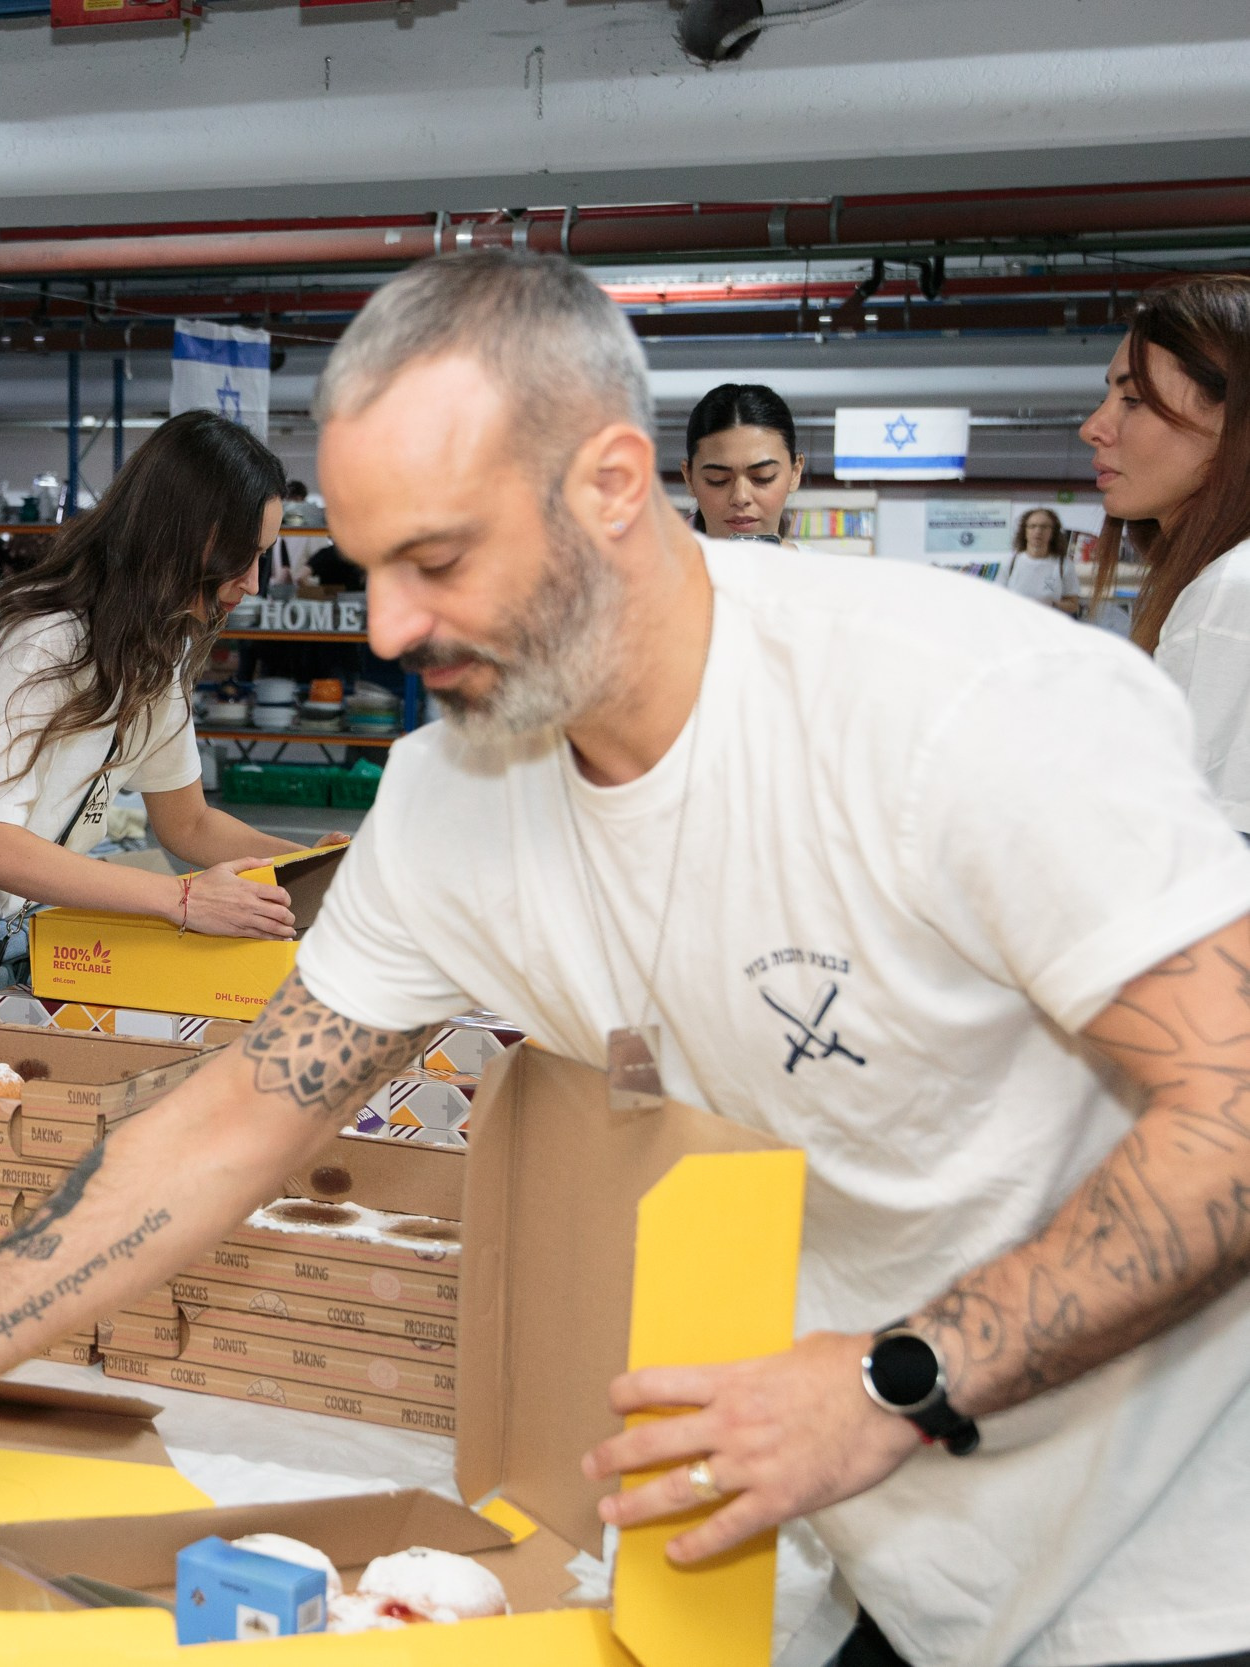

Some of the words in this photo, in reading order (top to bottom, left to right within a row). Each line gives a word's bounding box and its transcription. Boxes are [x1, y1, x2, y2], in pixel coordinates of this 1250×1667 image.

[260, 601, 361, 631] HOME
[53, 946, 90, 961] 100%
[53, 960, 111, 974] RECYCLABLE
[53, 977, 76, 985] dhl.com
[215, 993, 232, 1002] DHL
[235, 994, 268, 1006] Express
[67, 1090, 101, 1106] DONUTS
[31, 1127, 62, 1143] BAKING
[2, 1169, 51, 1187] PROFITEROLE
[215, 1250, 249, 1269] DONUTS
[295, 1263, 328, 1281] BAKING
[437, 1284, 457, 1300] DON
[173, 1282, 208, 1301] COOKIES
[327, 1308, 365, 1326] COOKIES
[404, 1320, 455, 1340] PROFITEROL
[213, 1336, 248, 1355] DONUTS
[293, 1350, 326, 1368] BAKING
[434, 1374, 454, 1390] DON
[171, 1367, 206, 1386] COOKIES
[325, 1395, 362, 1414] COOKIES
